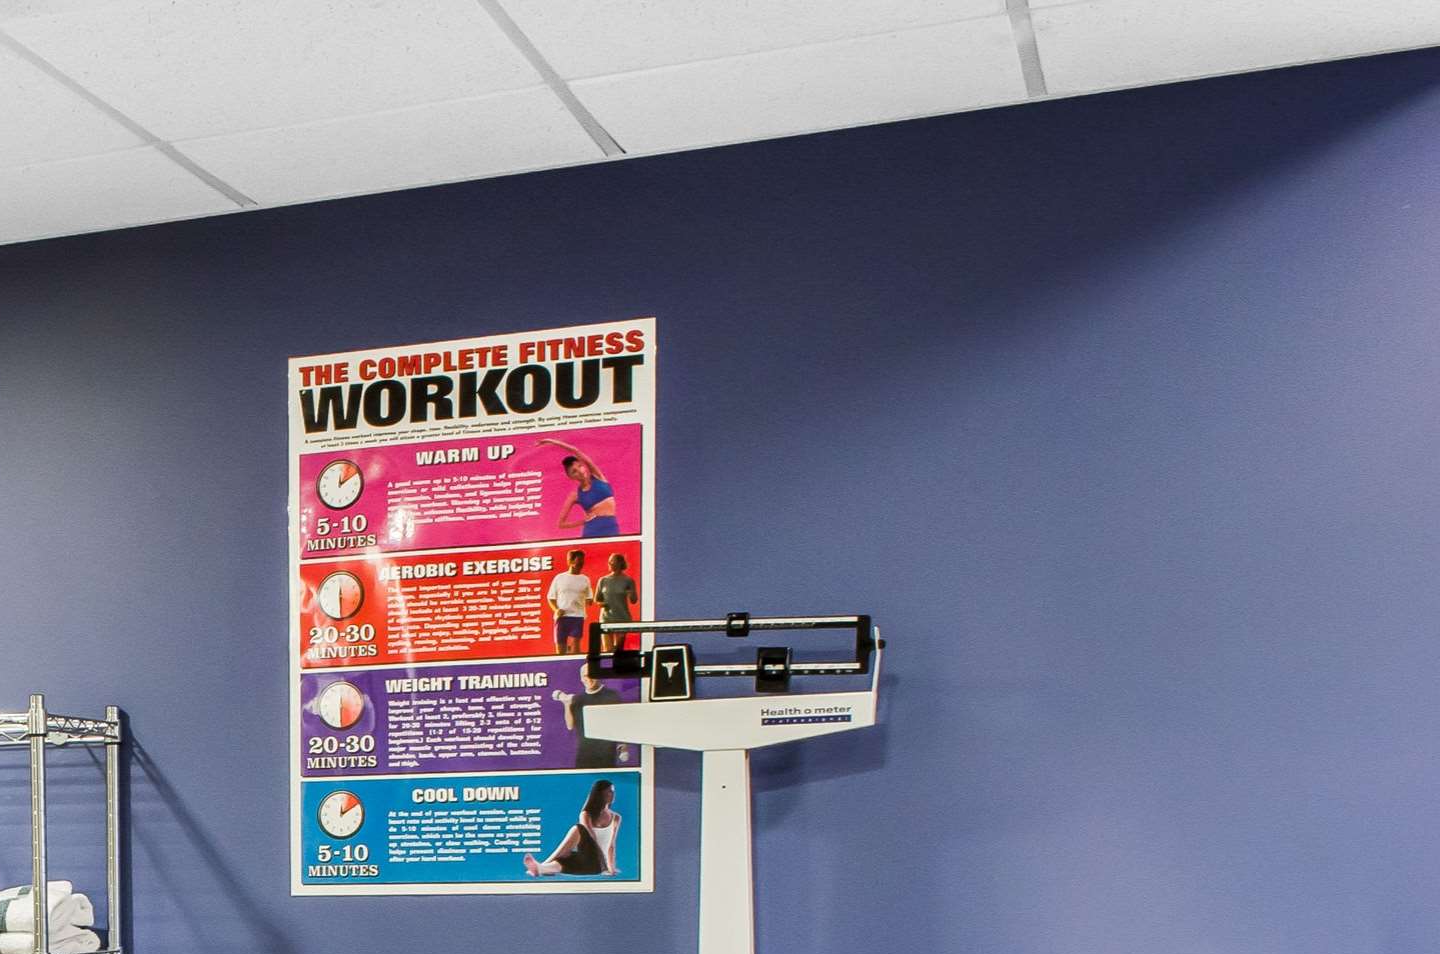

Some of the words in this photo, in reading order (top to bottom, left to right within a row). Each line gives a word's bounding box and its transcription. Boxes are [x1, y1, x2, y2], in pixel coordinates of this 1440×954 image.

[299, 362, 349, 387] THE
[358, 344, 508, 381] COMPLETE
[519, 329, 645, 364] FITNESS
[298, 353, 645, 434] WORKOUT
[416, 447, 479, 467] WARM
[487, 444, 515, 462] UP
[316, 514, 368, 536] 5-10
[307, 535, 377, 552] MINUTES
[379, 560, 457, 581] AEROBIC
[462, 556, 553, 578] EXERCISE
[310, 624, 375, 645] 20-30
[307, 644, 377, 660] MINUTES
[385, 676, 452, 695] WEIGHT
[457, 672, 548, 692] TRAINING
[761, 707, 801, 717] Health
[814, 705, 852, 714] meter
[308, 735, 375, 755] 20-30
[306, 755, 378, 770] MINUTES
[411, 787, 457, 804] COOL
[463, 786, 520, 802] DOWN
[317, 844, 369, 863] 5-10
[308, 864, 379, 878] MINUTES
